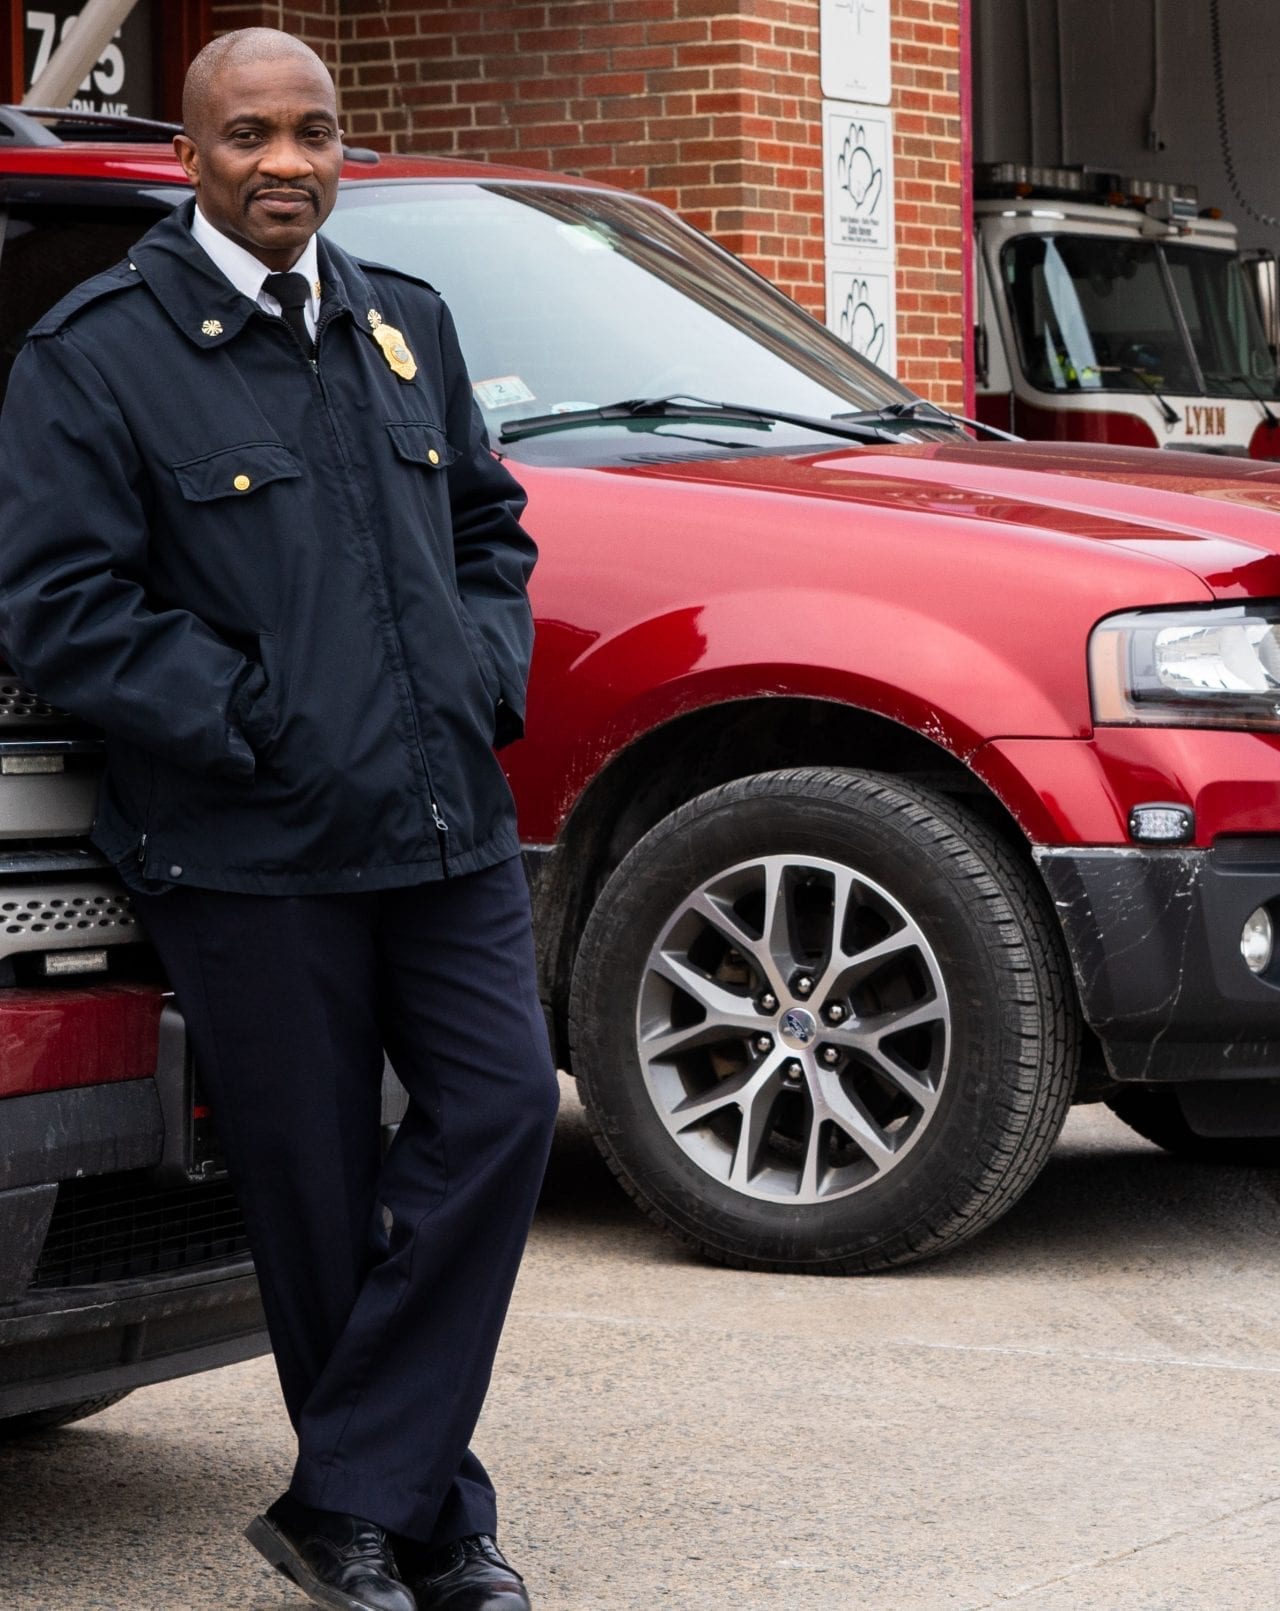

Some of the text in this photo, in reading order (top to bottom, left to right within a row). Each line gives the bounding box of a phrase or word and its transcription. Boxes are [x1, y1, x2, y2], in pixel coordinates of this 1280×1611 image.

[101, 102, 128, 117] AVE
[495, 384, 506, 393] 2
[1185, 406, 1225, 434] LYNN
